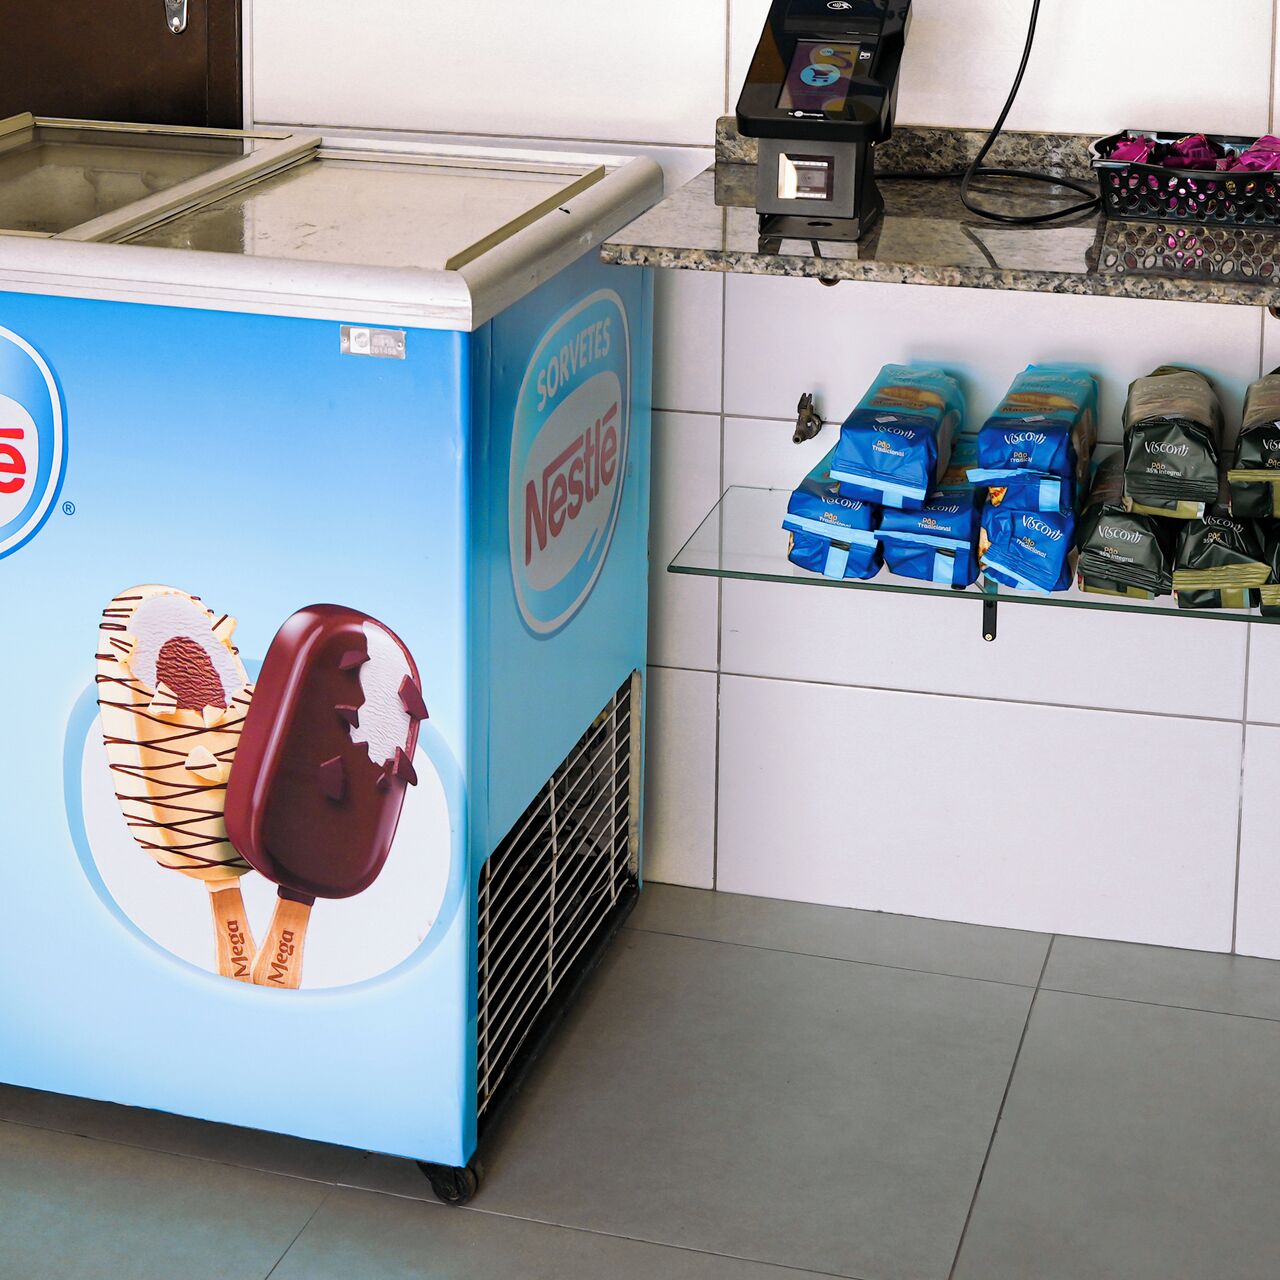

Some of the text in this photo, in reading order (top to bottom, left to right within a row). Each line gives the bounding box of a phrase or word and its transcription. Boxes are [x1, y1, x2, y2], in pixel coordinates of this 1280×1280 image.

[536, 318, 611, 412] SORVETES
[877, 440, 890, 449] Pão
[1004, 432, 1046, 444] Visconti
[872, 445, 905, 457] Tradicional
[1144, 441, 1189, 457] Visconti
[1151, 462, 1166, 470] Pão
[525, 402, 617, 566] Nestlé
[918, 522, 951, 532] Tradicional
[923, 518, 936, 526] Pão
[1022, 514, 1064, 541] Visconti
[1098, 525, 1142, 544] Visconti
[1016, 537, 1047, 558] Tradicional
[1104, 546, 1118, 554] Pão
[227, 920, 250, 977] Mega
[267, 930, 294, 984] Mega
